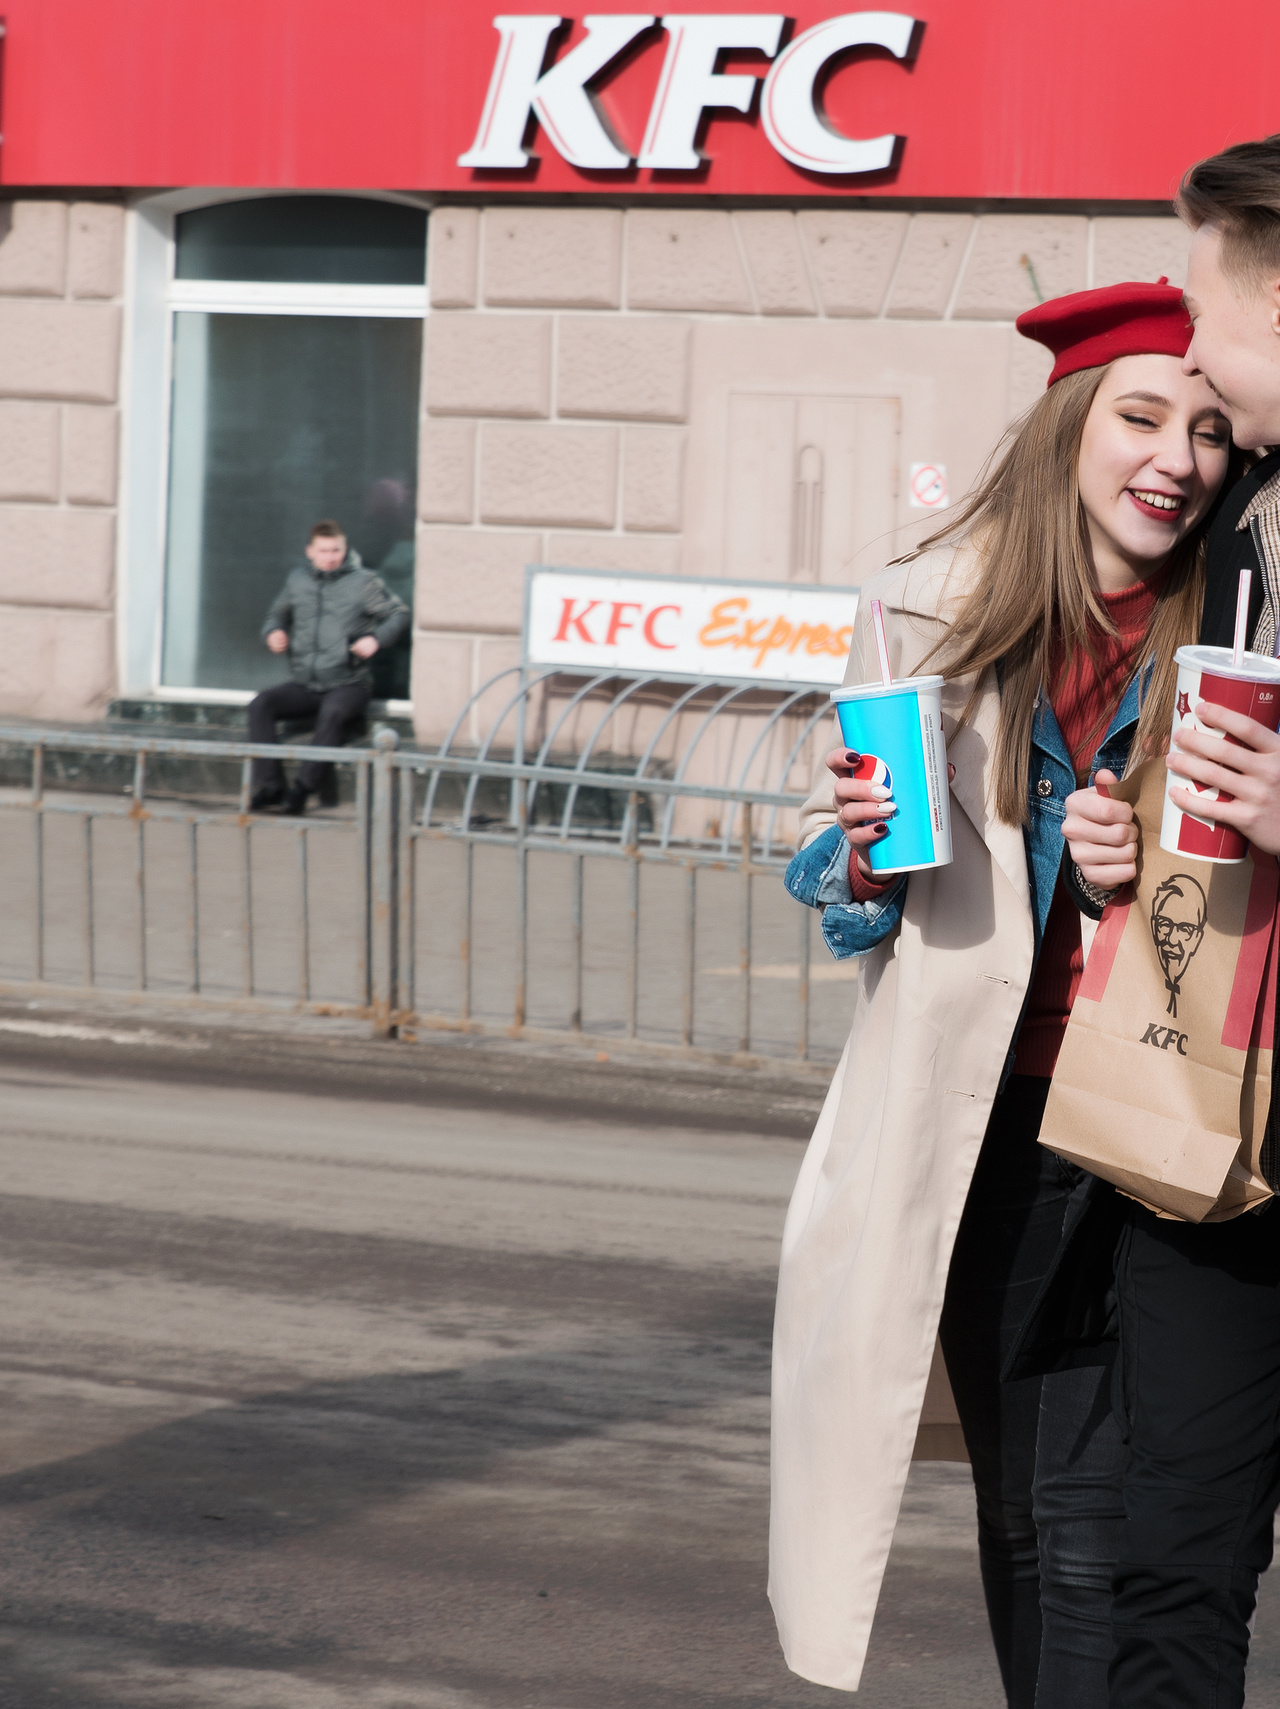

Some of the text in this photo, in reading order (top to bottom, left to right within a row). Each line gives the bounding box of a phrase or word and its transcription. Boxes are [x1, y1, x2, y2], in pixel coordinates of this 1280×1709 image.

[457, 11, 918, 176] KFC
[551, 597, 855, 669] KFC Expres
[1139, 1022, 1189, 1056] KFC
